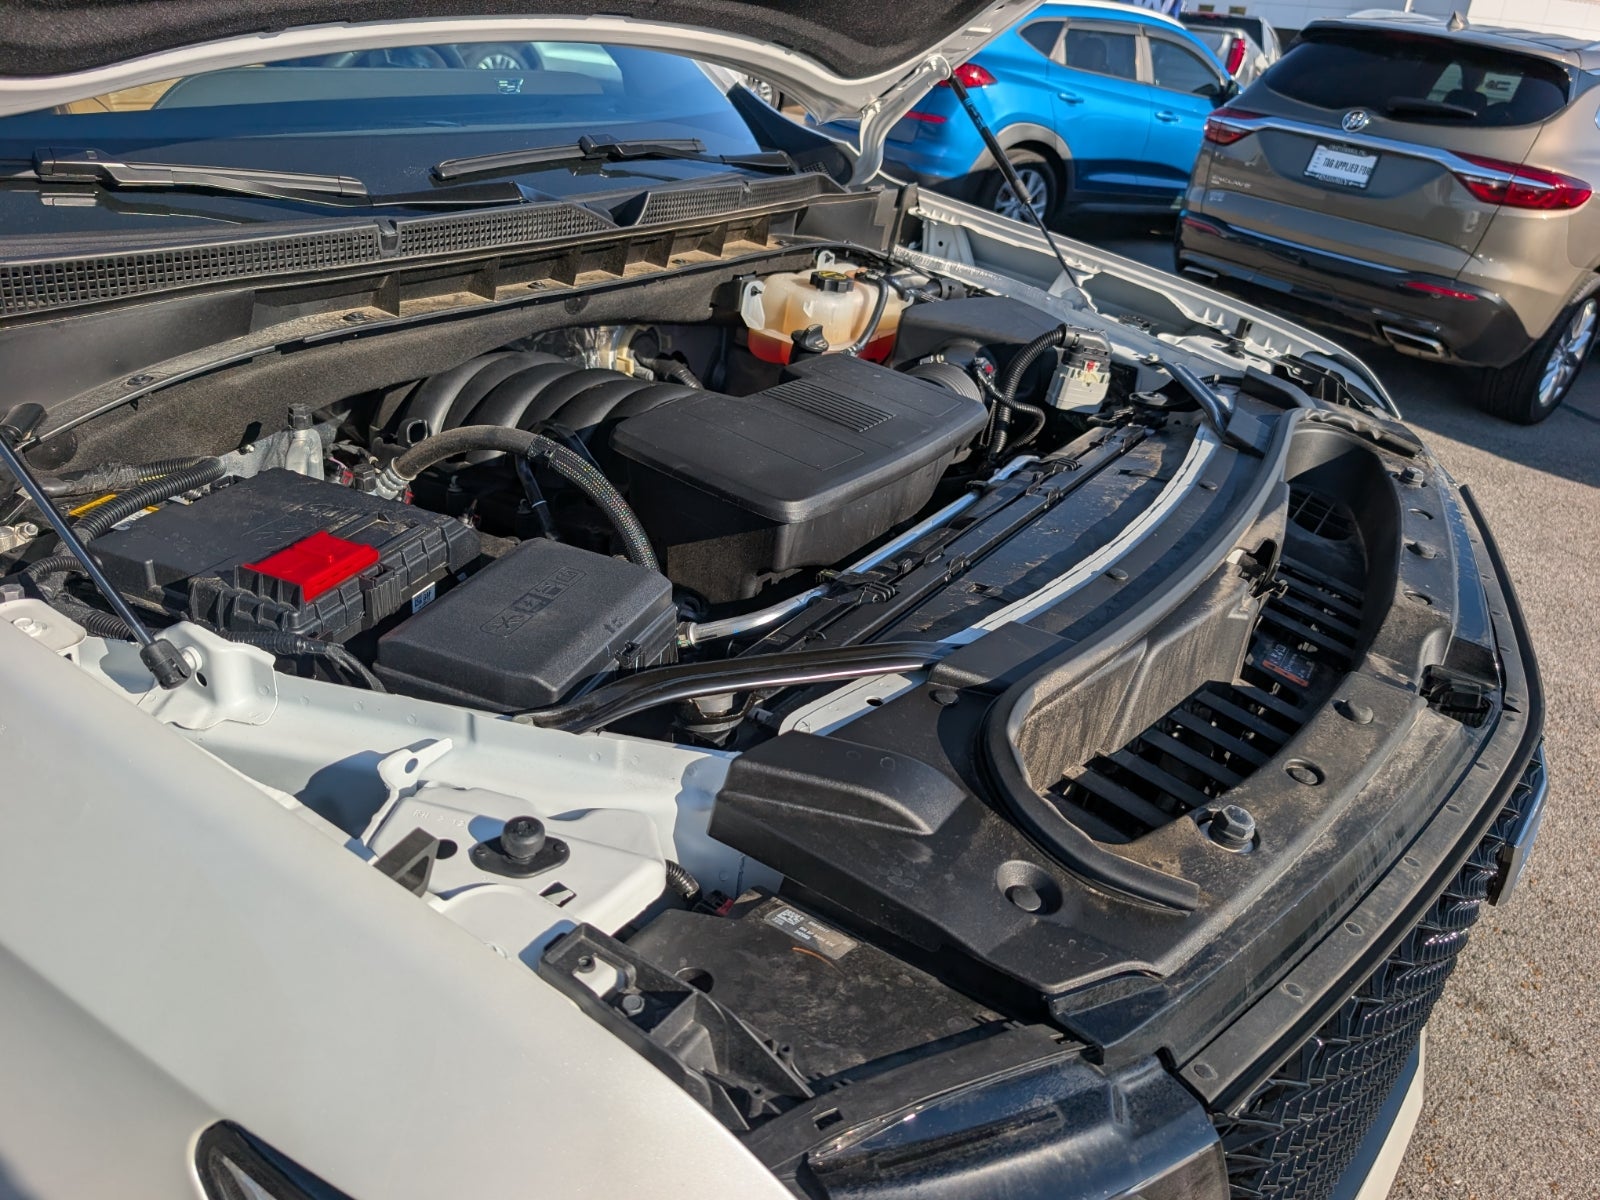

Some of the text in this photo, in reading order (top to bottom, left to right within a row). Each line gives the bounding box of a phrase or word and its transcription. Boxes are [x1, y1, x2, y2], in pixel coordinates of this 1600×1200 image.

[1323, 157, 1372, 176] TAG APPLIED FOR
